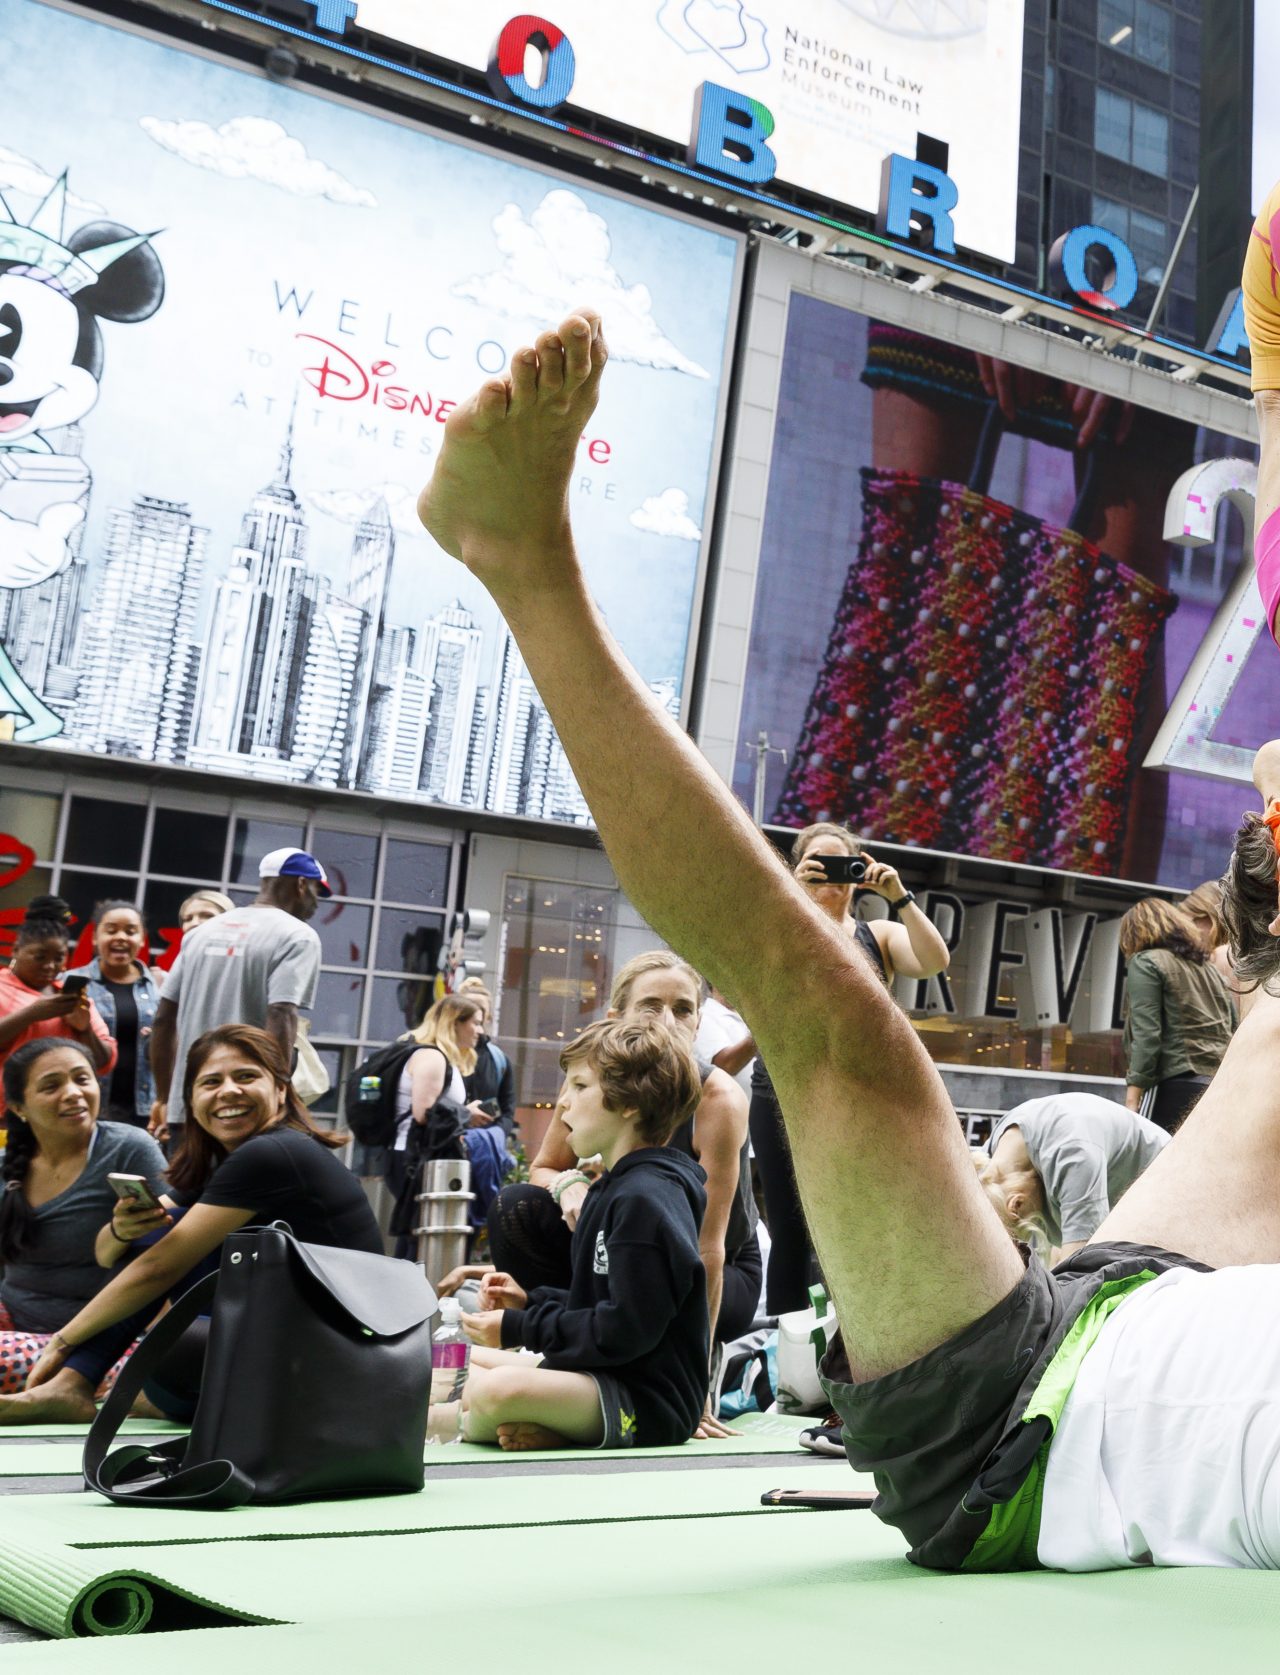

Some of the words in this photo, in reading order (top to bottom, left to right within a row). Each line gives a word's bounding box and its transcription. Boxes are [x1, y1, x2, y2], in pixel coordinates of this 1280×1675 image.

[781, 69, 873, 118] Museum
[784, 47, 921, 116] Enforcement
[785, 26, 873, 76] National
[884, 66, 924, 95] Law
[274, 279, 507, 375] WELCO
[247, 347, 273, 368] TO
[295, 333, 459, 424] Disne
[312, 408, 433, 457] TIMES
